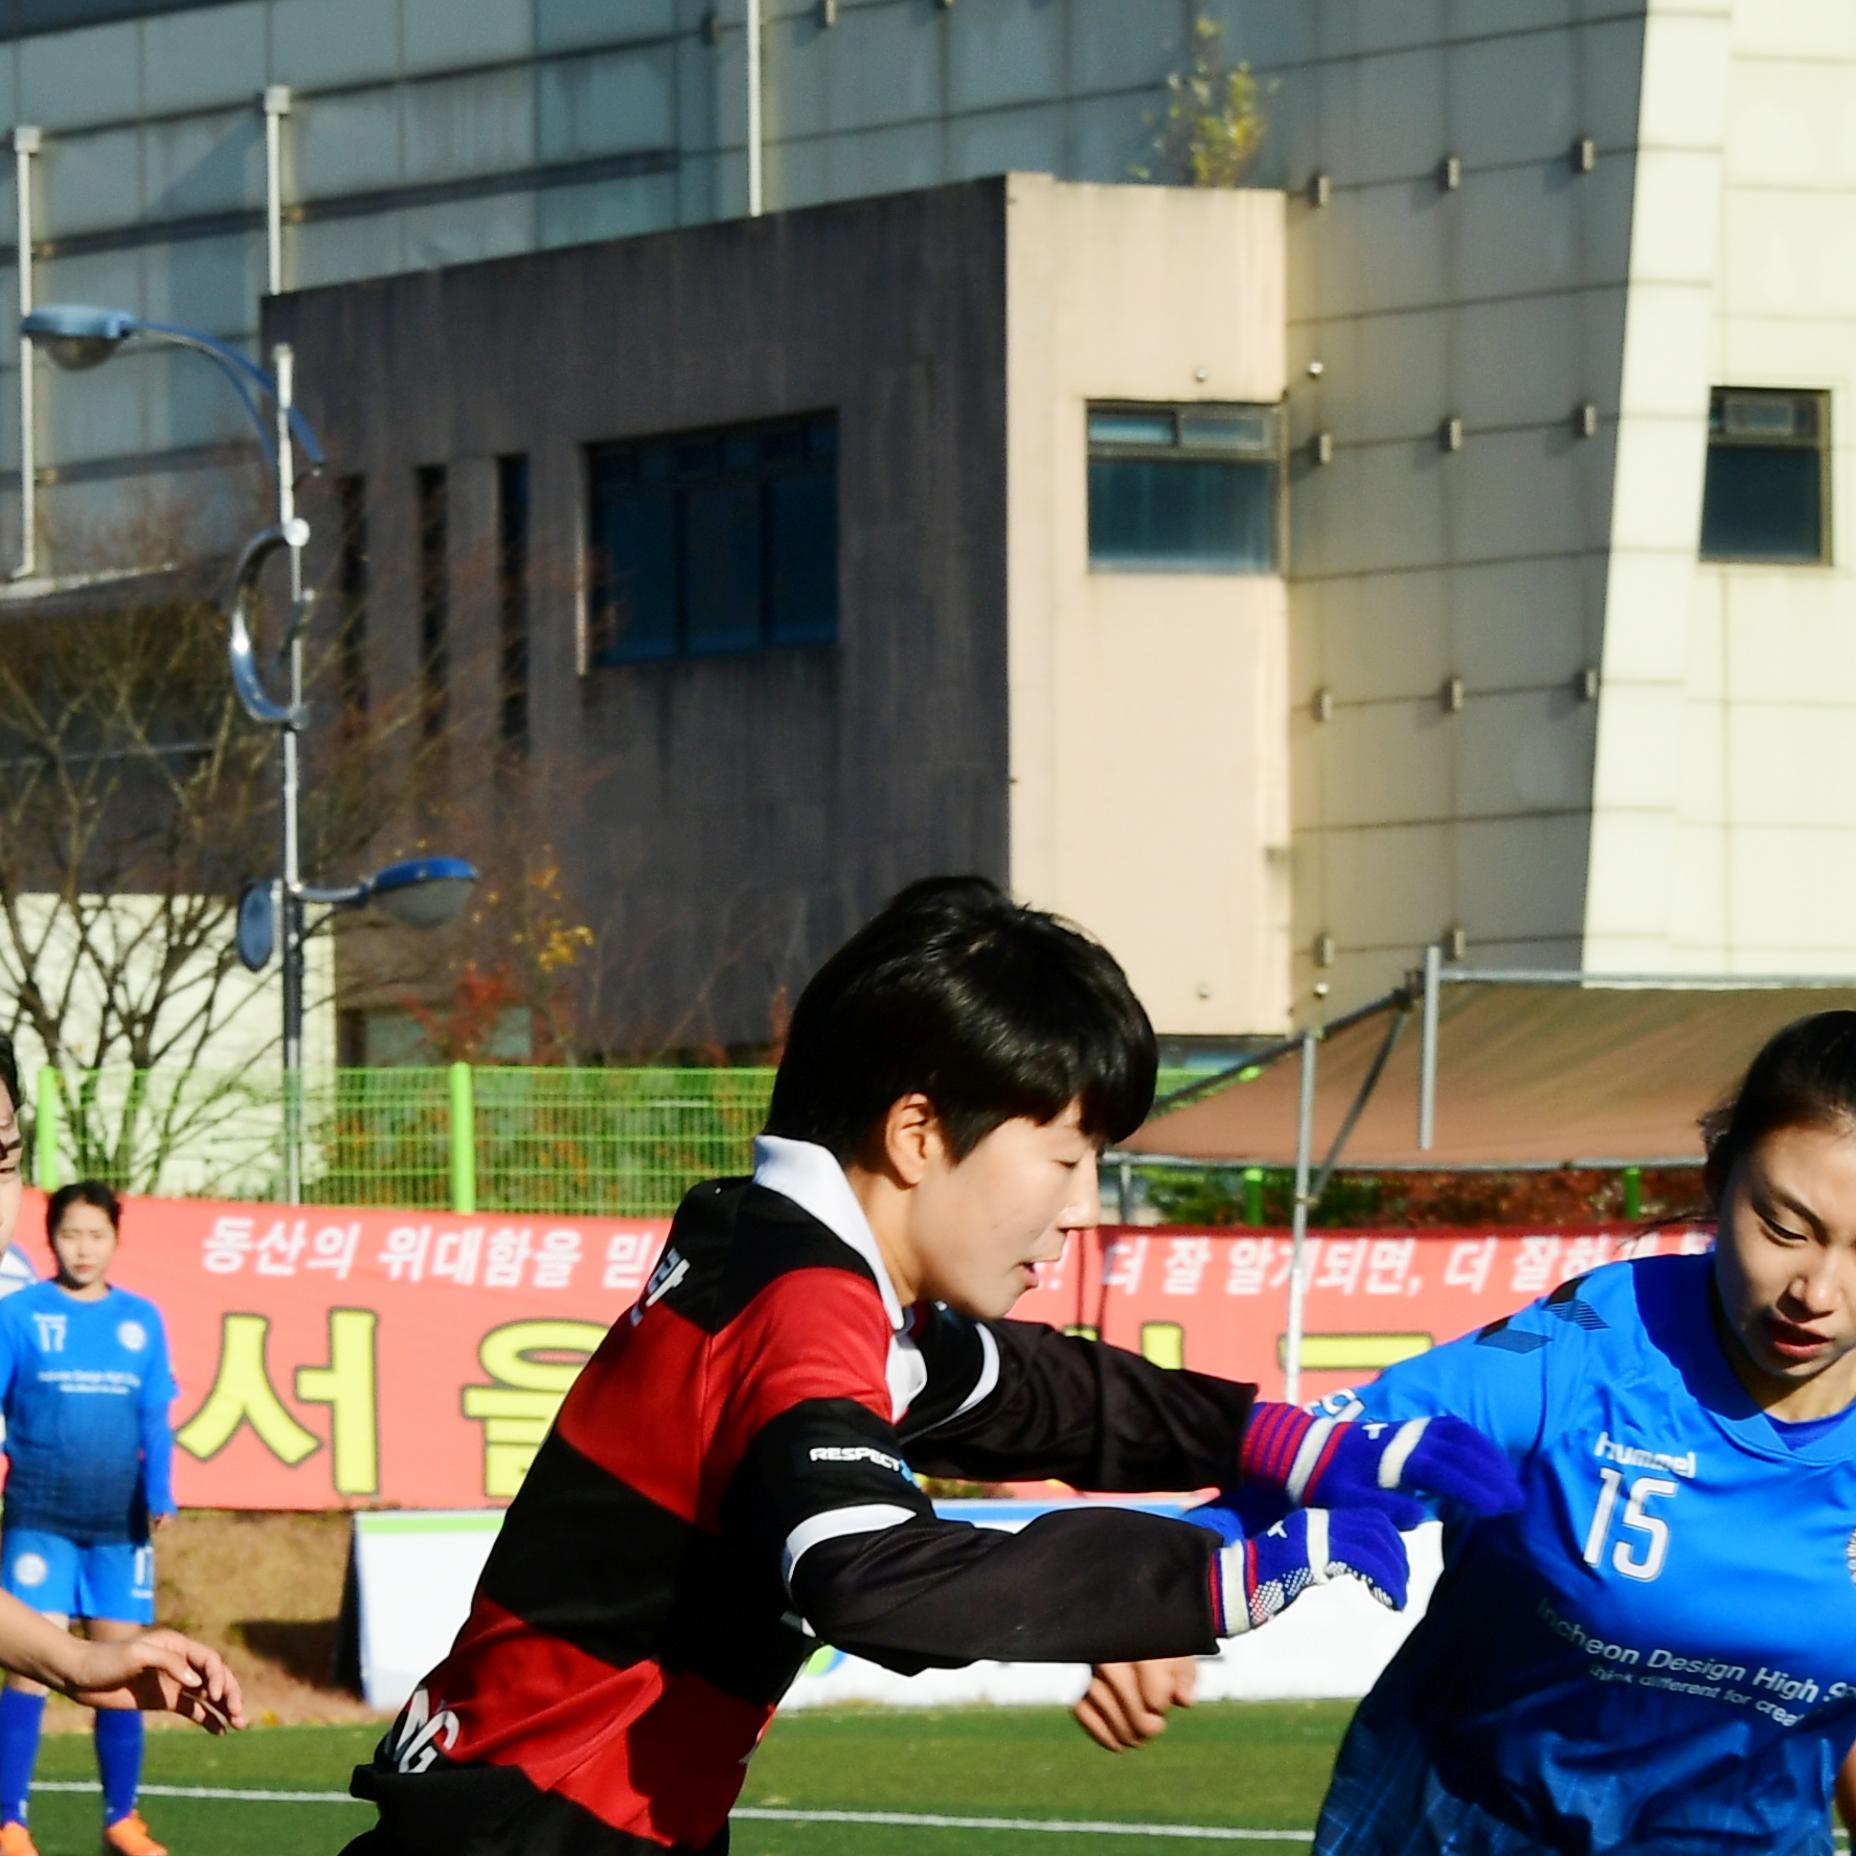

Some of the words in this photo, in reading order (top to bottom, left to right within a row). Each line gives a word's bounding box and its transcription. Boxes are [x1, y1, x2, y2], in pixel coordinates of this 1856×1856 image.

[203, 1216, 361, 1280] 동산의
[378, 1224, 583, 1289] 위대함을
[602, 1232, 664, 1290] 믿
[1103, 1237, 1148, 1296] 더
[1163, 1237, 1211, 1295] 잘
[1444, 1236, 1498, 1294] 더
[809, 1447, 900, 1472] RESPECT
[1594, 1431, 1696, 1478] hummel
[1583, 1467, 1678, 1582] 15
[1648, 1649, 1747, 1682] Design
[1752, 1666, 1821, 1704] High
